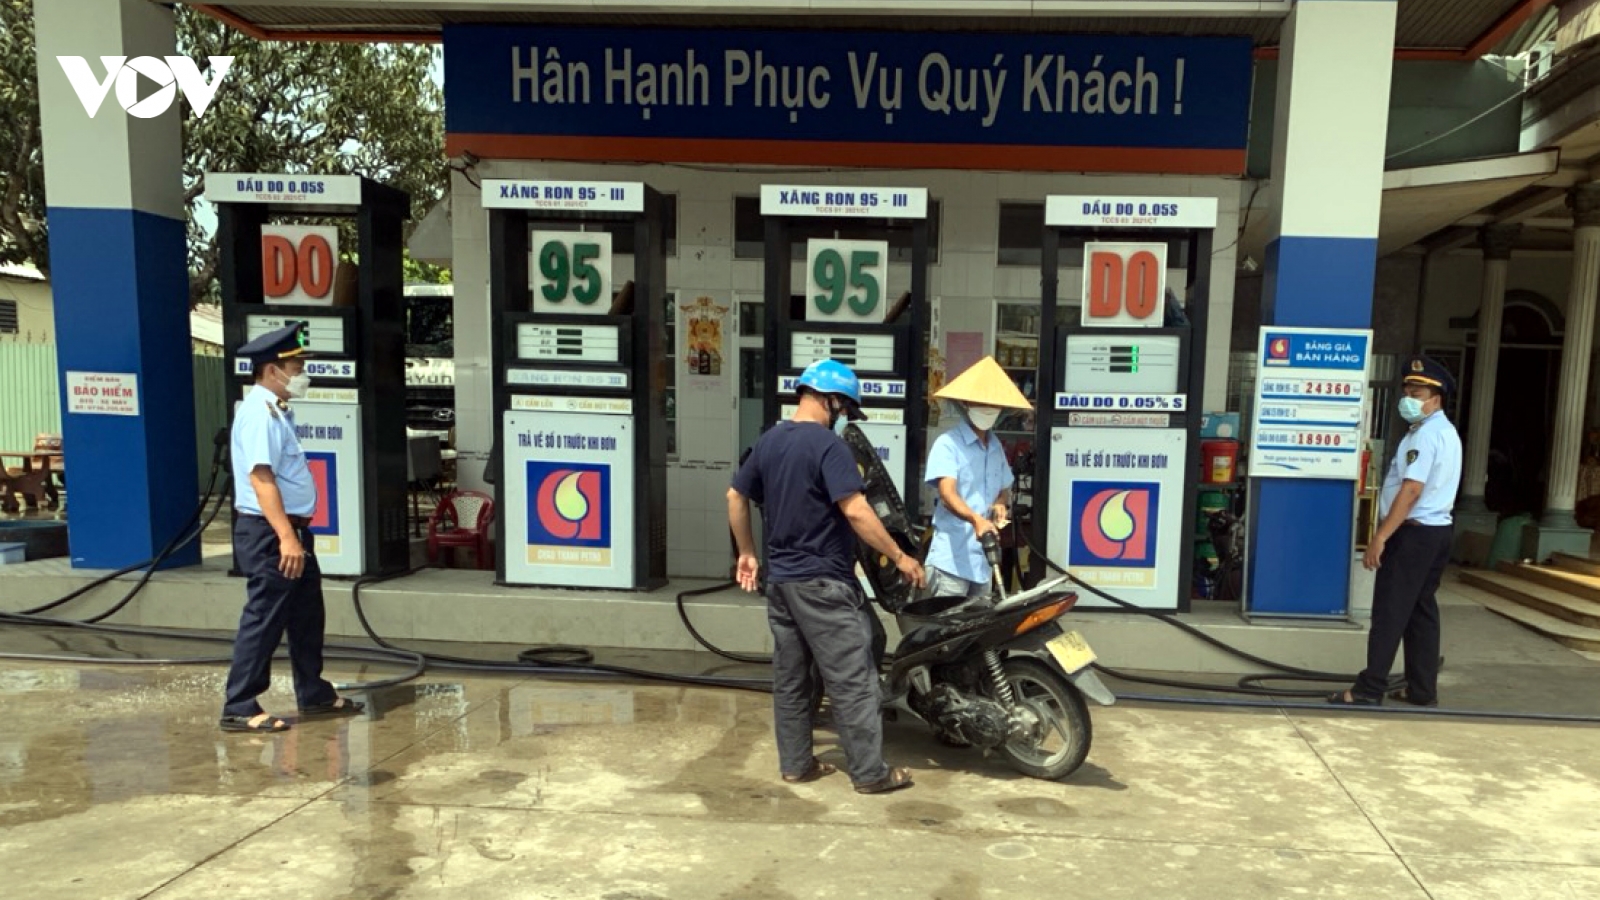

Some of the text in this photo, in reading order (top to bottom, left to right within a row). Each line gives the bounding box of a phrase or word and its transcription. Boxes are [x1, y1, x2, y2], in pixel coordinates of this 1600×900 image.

[511, 46, 1185, 127] Hân Hạnh Phục Vụ Quý Khách !
[268, 181, 284, 192] DO
[500, 184, 539, 198] XĂNG
[544, 186, 573, 199] RON
[578, 187, 596, 200] 95
[611, 188, 625, 200] III
[780, 190, 820, 205] XĂNG
[825, 192, 855, 206] RON
[860, 193, 878, 207] 95
[893, 194, 908, 207] III
[1116, 203, 1134, 216] DO
[1139, 203, 1178, 216] 0.05S
[262, 234, 334, 299] DO
[540, 239, 602, 305] 95
[813, 248, 880, 316] 95
[1089, 250, 1159, 319] DO
[342, 364, 351, 375] S
[863, 382, 882, 393] 95
[1305, 382, 1351, 395] 24360
[1093, 397, 1114, 407] DO
[1172, 398, 1182, 408] S
[1298, 433, 1341, 446] 18900
